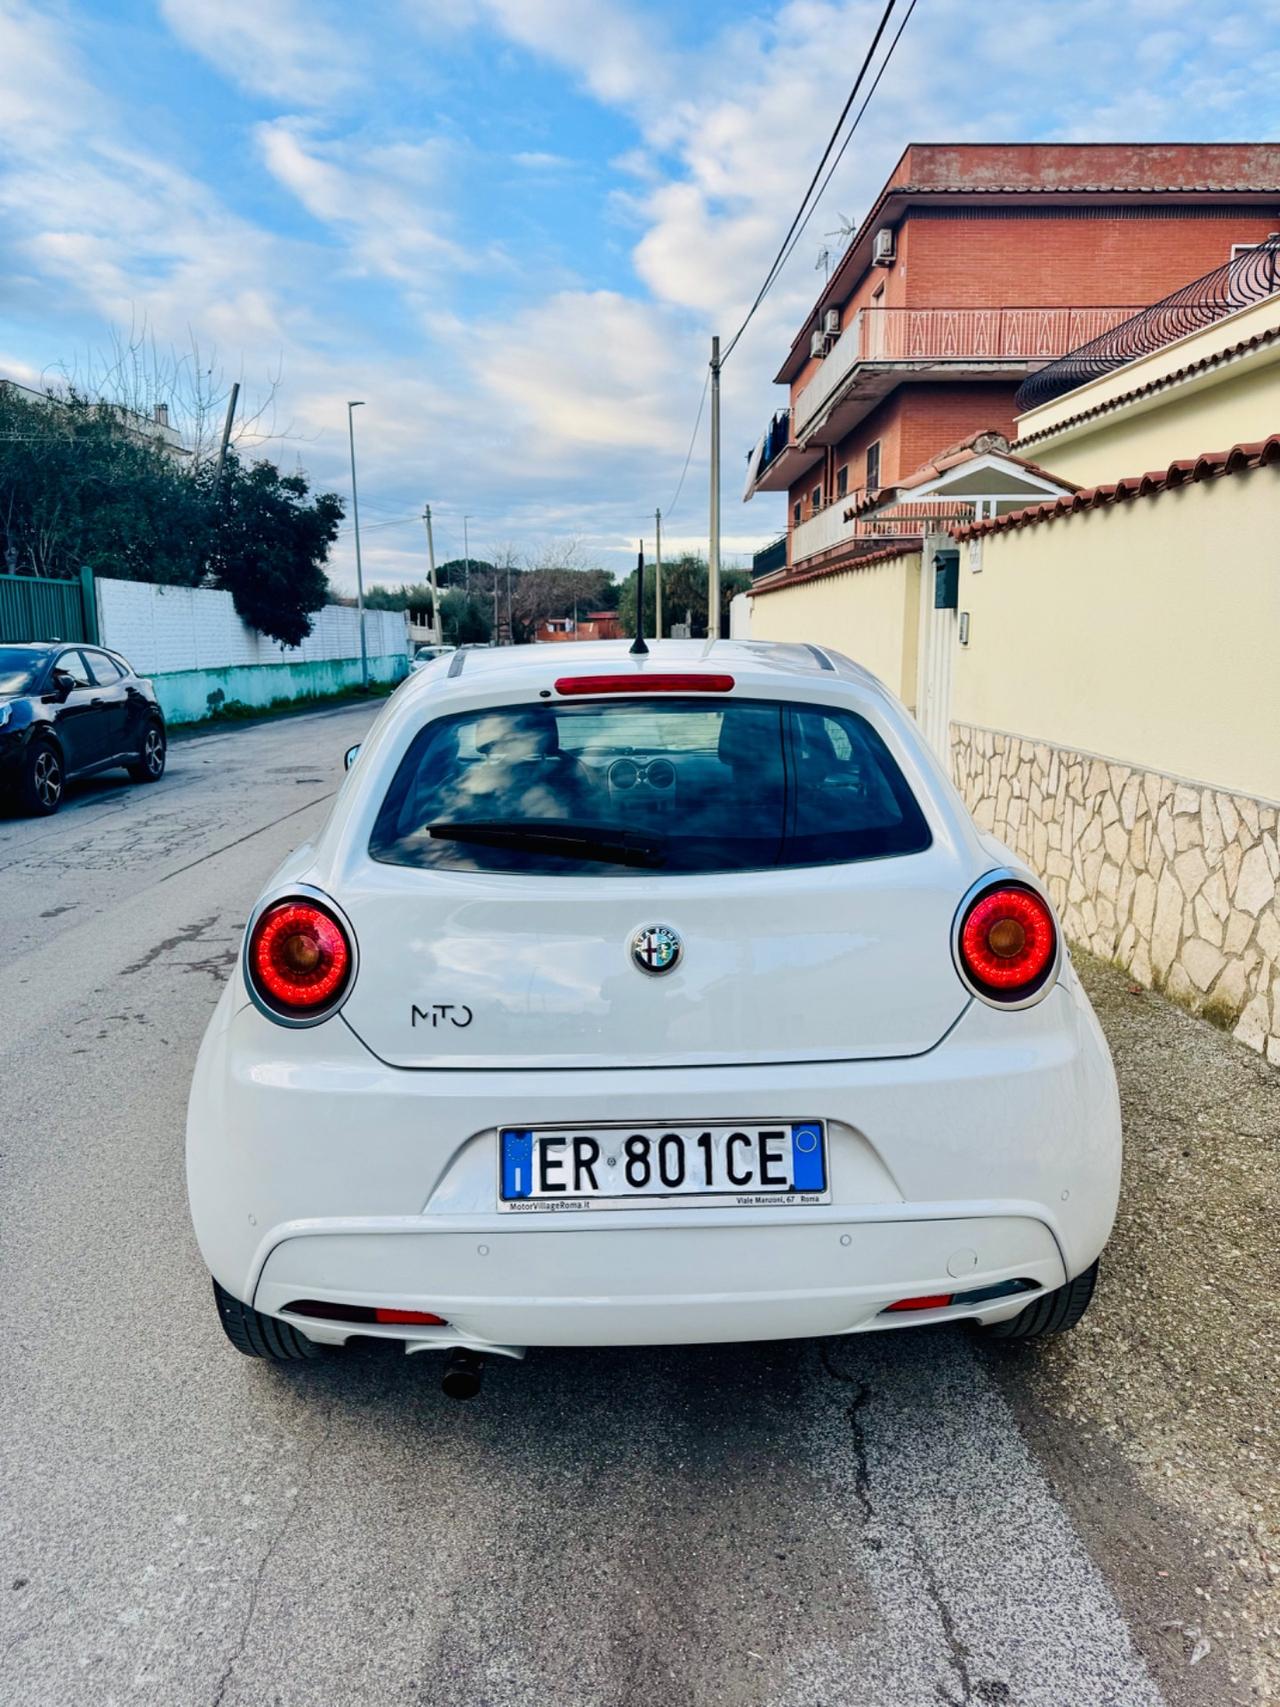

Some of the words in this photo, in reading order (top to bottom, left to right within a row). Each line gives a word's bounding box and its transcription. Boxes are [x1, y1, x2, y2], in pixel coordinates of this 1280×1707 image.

[539, 1136, 600, 1192] ER
[624, 1131, 788, 1189] 801CE
[800, 1195, 820, 1203] Roma
